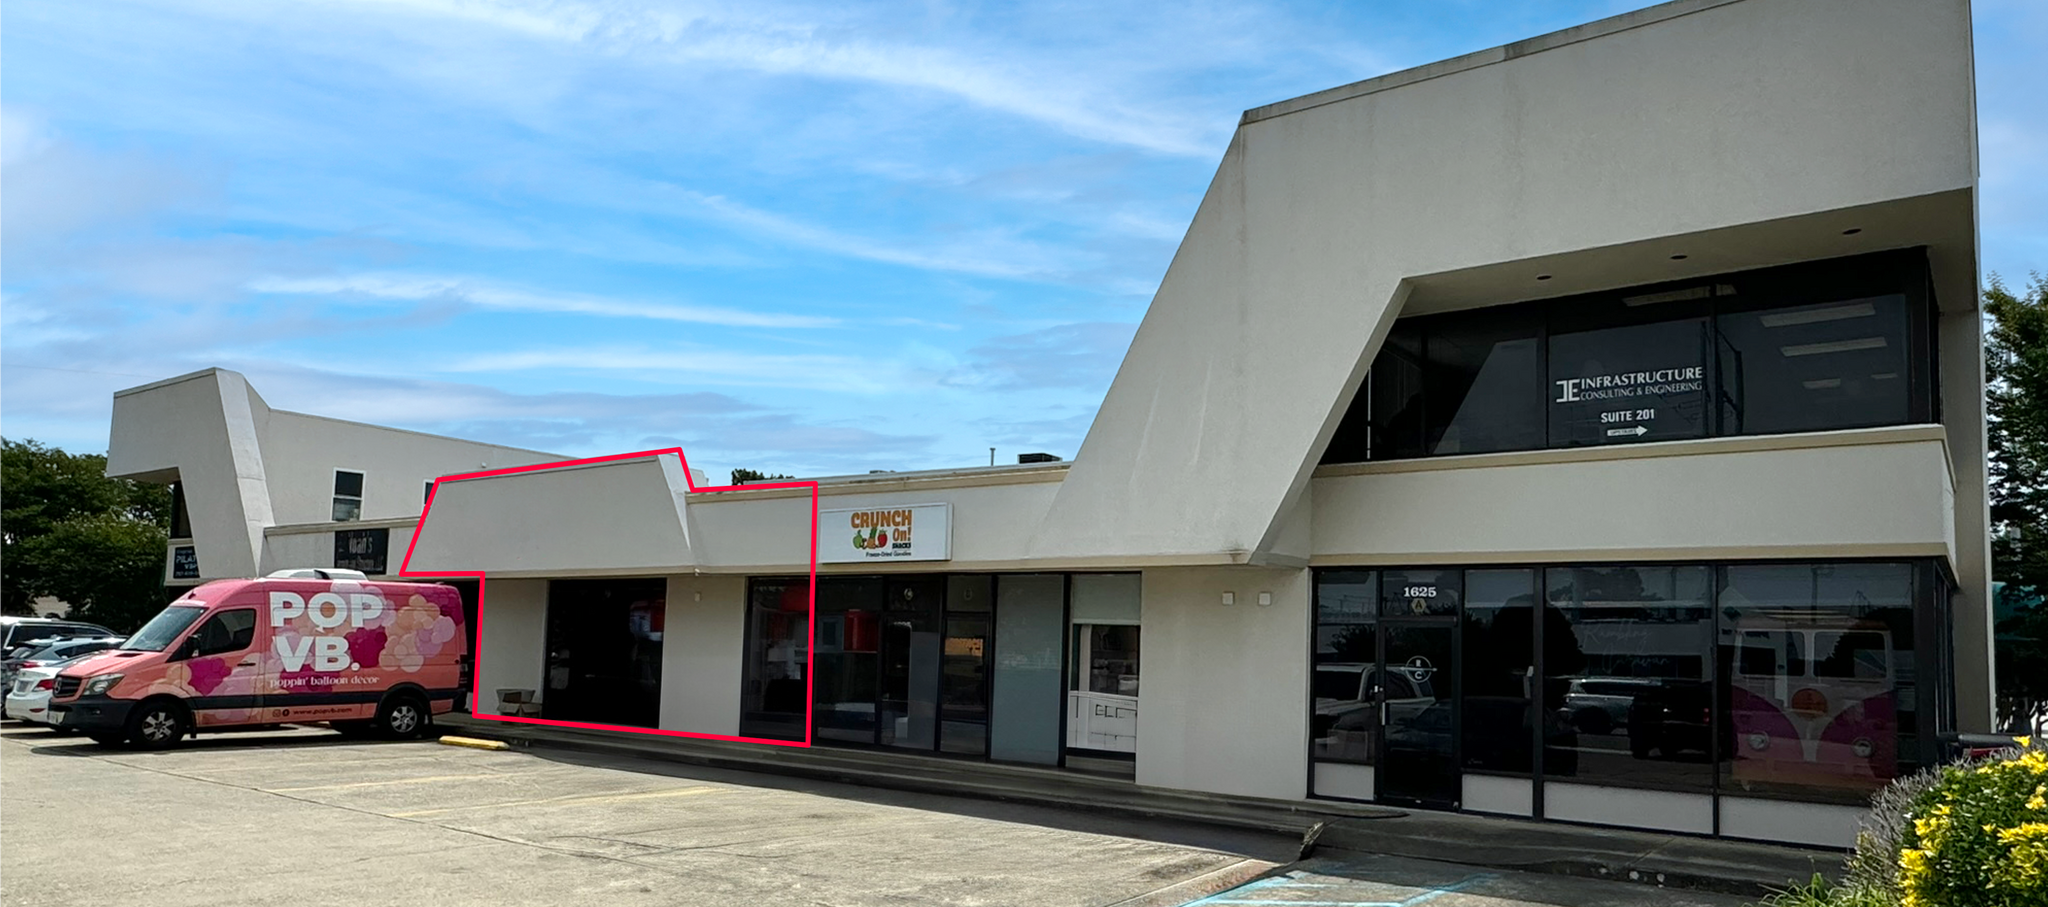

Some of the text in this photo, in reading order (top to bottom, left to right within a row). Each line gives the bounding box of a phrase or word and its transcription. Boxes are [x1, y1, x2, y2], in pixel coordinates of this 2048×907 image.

[1581, 367, 1702, 389] INFRASTRUCTURE
[1580, 381, 1702, 401] CONSULTING & ENGINEERING
[1601, 409, 1655, 423] SUITE 201
[851, 510, 912, 528] CRUNCH
[893, 527, 912, 541] On!
[1404, 587, 1437, 597] 1625
[1415, 600, 1423, 609] A
[270, 592, 384, 633] POP
[272, 636, 360, 672] VB.
[270, 677, 308, 688] poppin'
[310, 676, 348, 686] balloon
[1414, 671, 1422, 679] C
